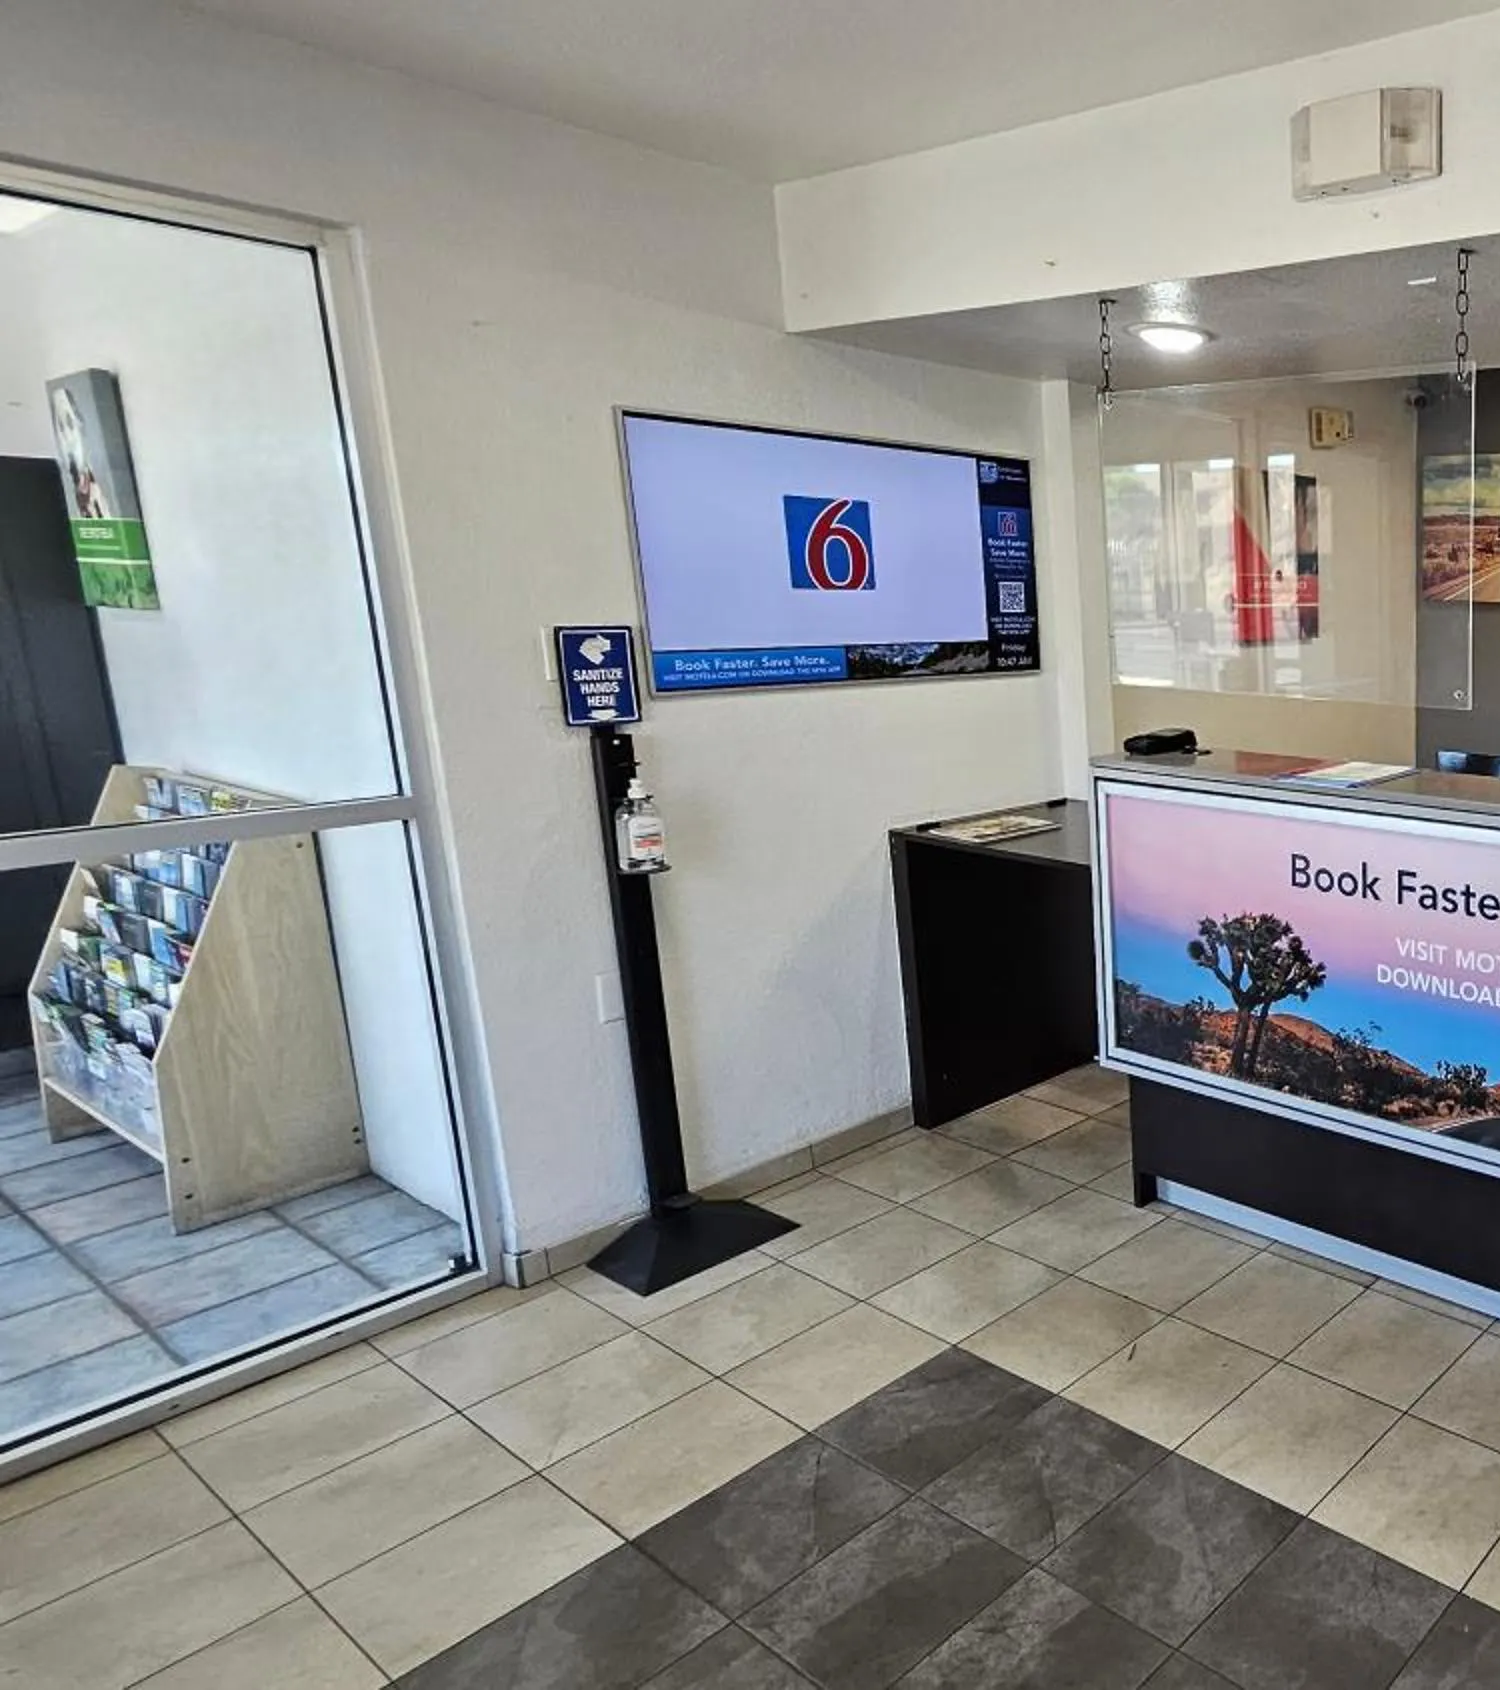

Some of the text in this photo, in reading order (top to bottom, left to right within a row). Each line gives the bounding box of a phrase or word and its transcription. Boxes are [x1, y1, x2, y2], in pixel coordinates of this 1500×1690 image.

[805, 497, 870, 591] 6
[675, 654, 830, 671] Book Faster. Save More.
[572, 667, 624, 682] SANITIZE
[579, 681, 620, 695] HANDS
[586, 694, 617, 707] HERE
[1290, 853, 1382, 901] Book
[1396, 938, 1447, 964] VISIT
